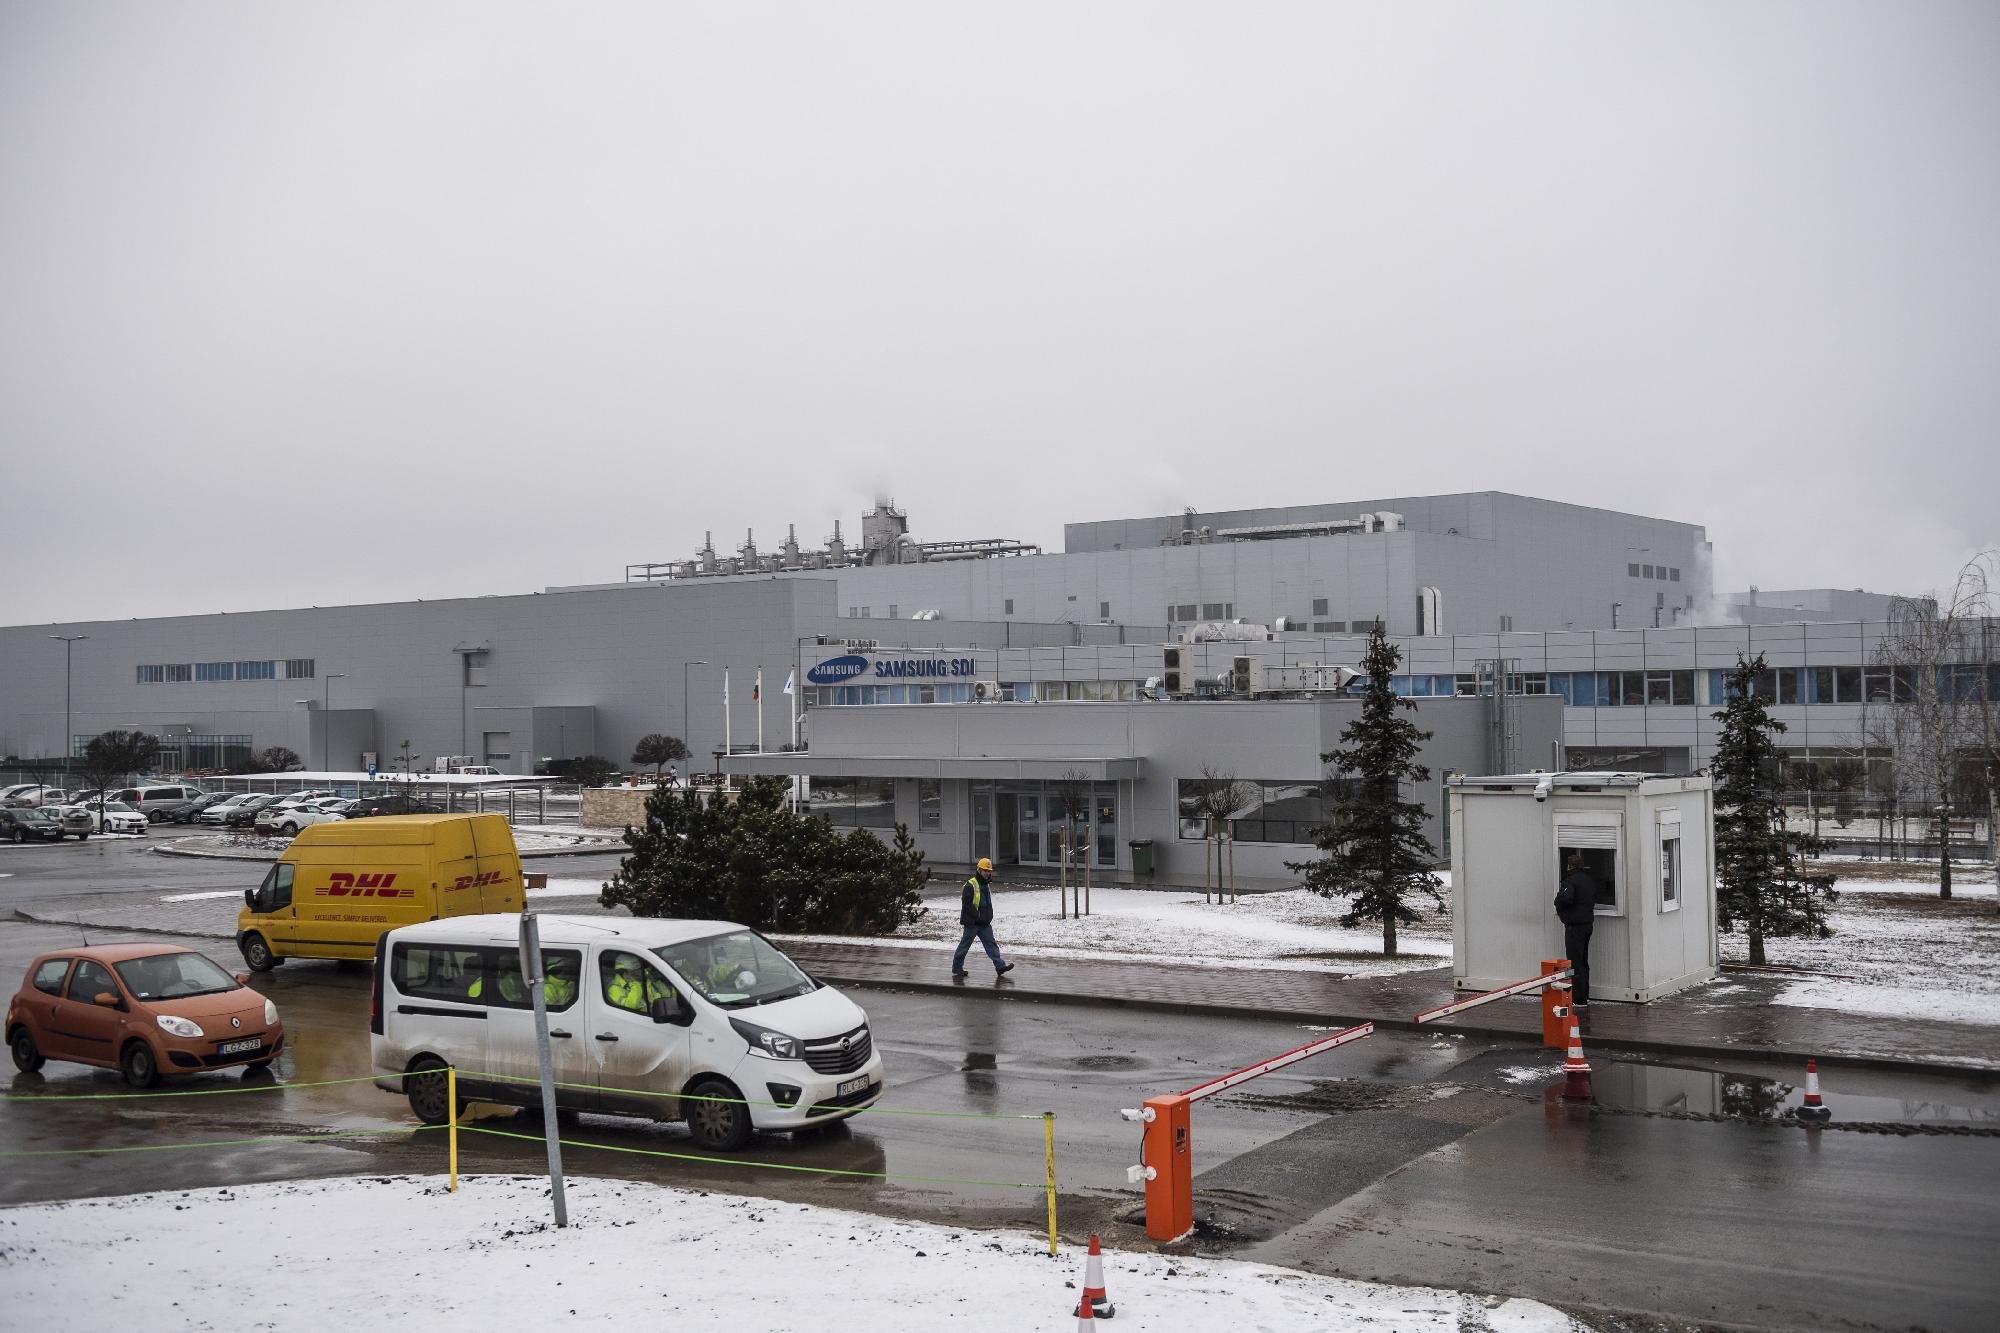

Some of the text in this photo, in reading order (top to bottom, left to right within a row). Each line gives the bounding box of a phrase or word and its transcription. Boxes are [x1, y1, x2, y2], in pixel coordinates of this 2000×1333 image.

[815, 664, 861, 676] SAMSUNG
[876, 658, 976, 677] SAMSUNG SDI
[328, 873, 400, 897] DHL
[454, 870, 505, 891] DHL
